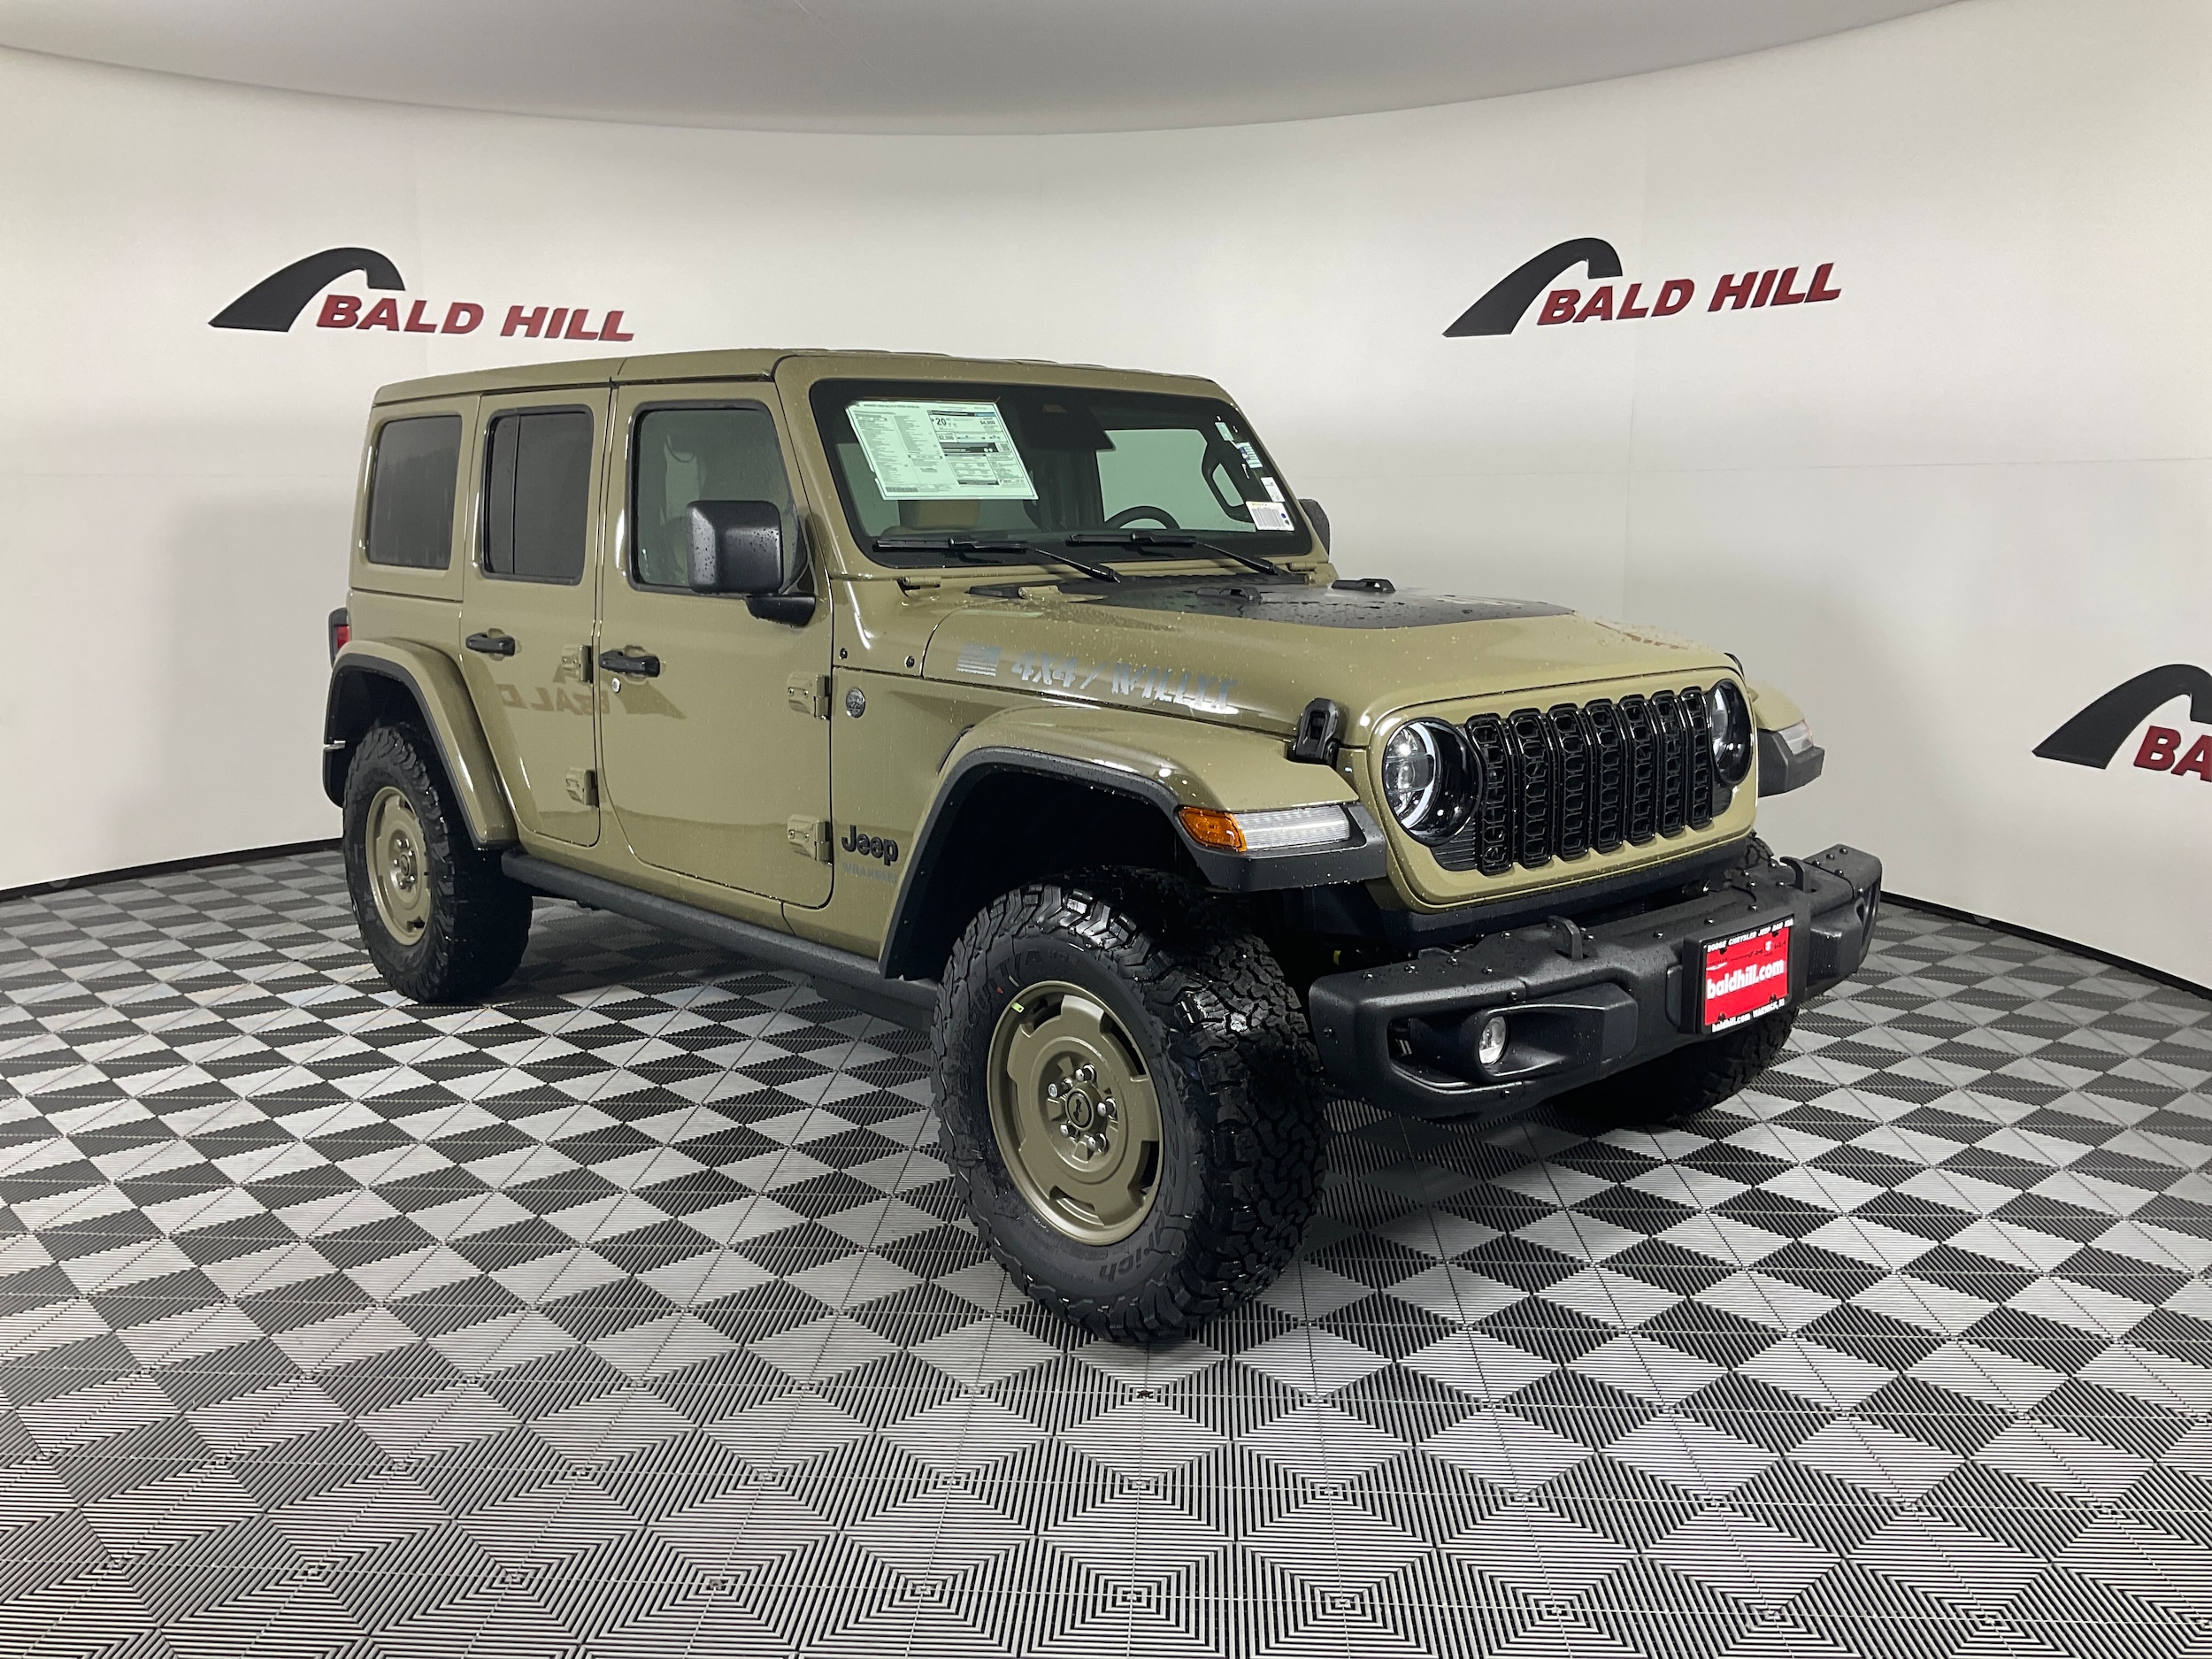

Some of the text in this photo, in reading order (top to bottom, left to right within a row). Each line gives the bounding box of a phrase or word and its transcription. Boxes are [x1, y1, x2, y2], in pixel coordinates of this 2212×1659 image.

[1537, 262, 1841, 326] BALD HILL
[316, 295, 634, 342] BALD HILL
[841, 825, 898, 866] Jeep
[1708, 918, 1793, 952] DODGE CHRYSLER JEEP RAM KIA
[1707, 959, 1785, 999] baldhill.com
[1712, 1012, 1751, 1033] baldhill.com
